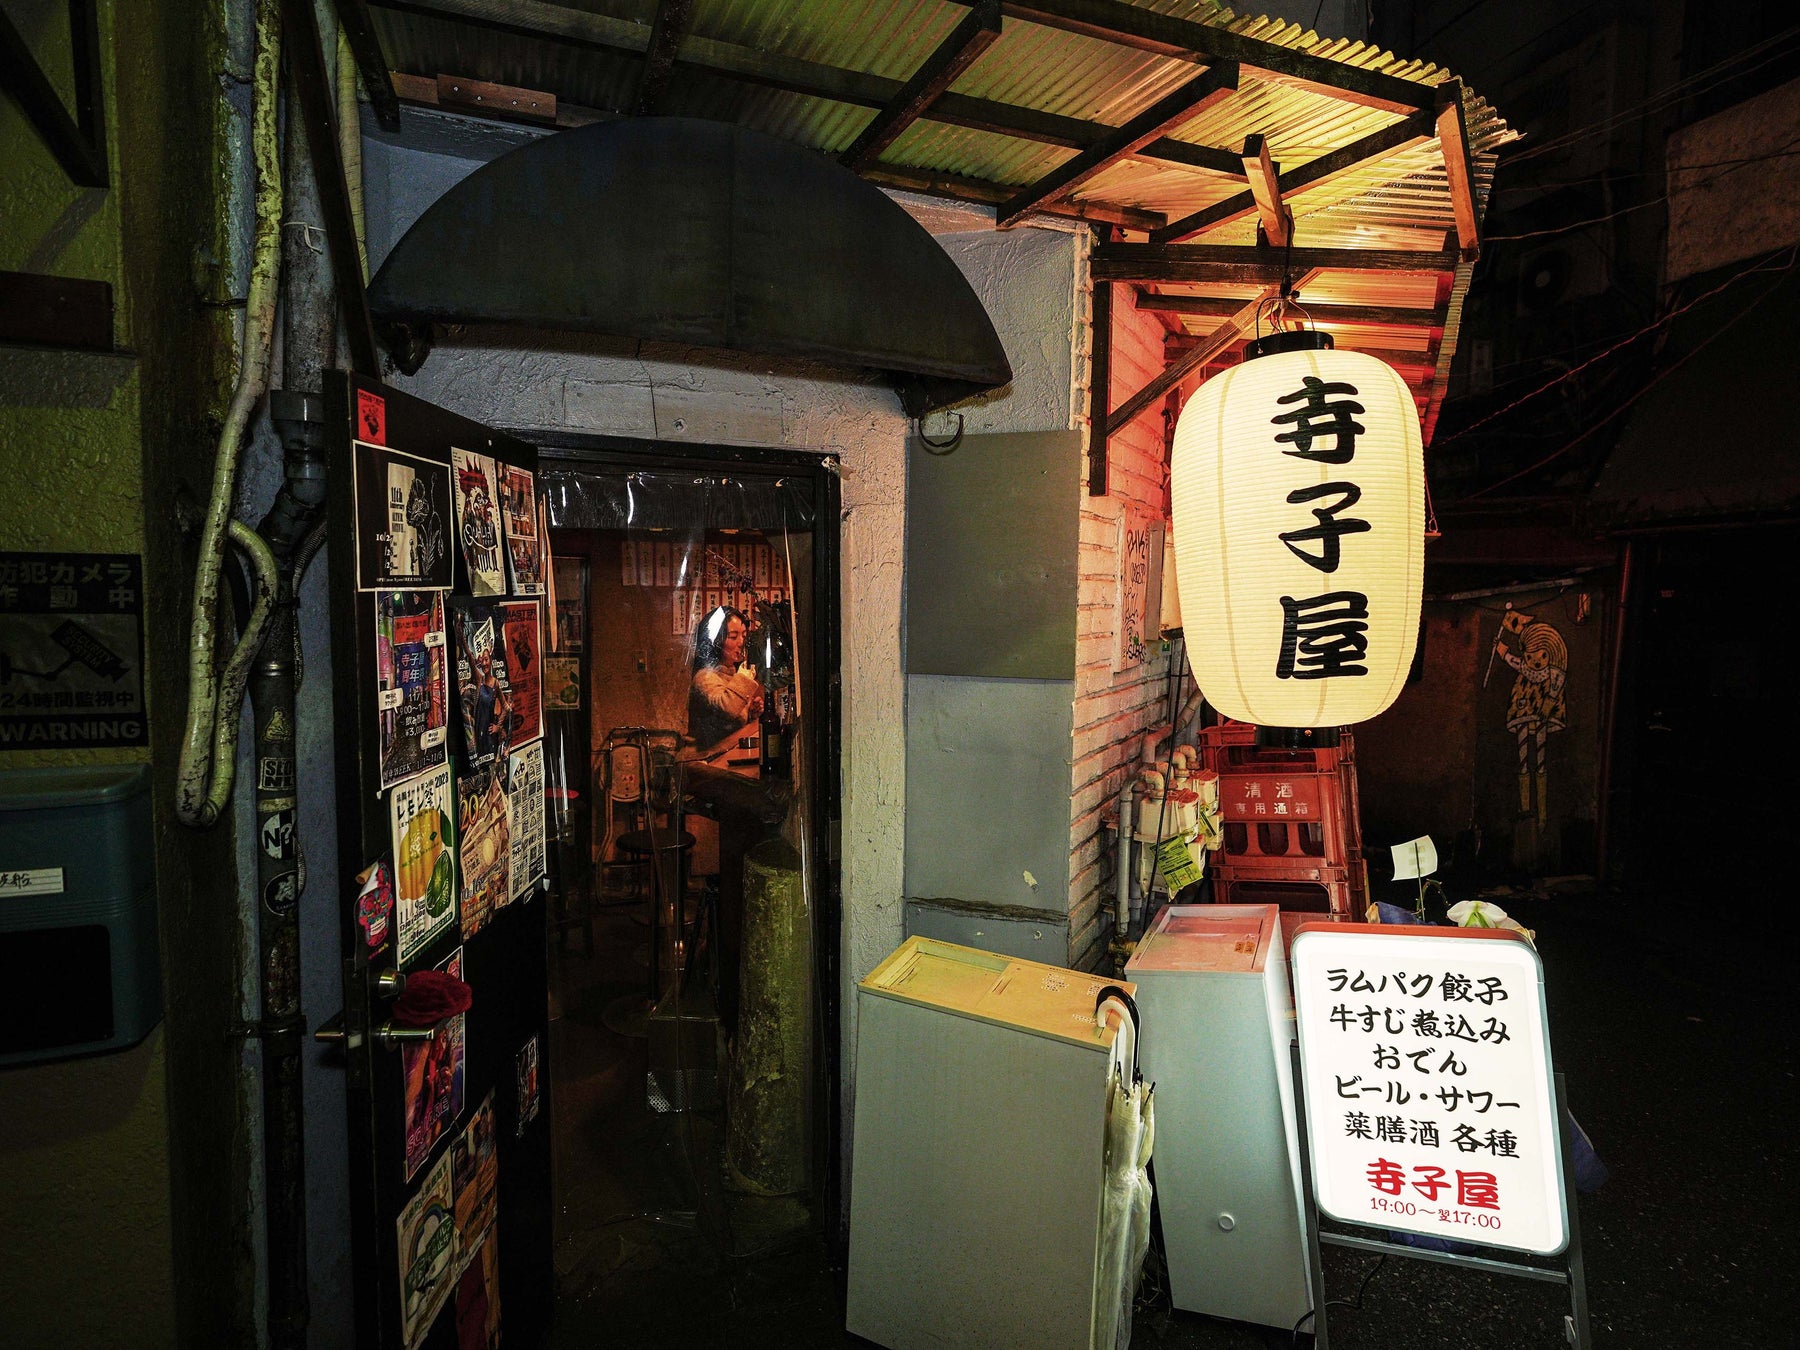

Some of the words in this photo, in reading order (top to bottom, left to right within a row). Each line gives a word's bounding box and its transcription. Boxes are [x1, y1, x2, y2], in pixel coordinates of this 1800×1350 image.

[1271, 376, 1372, 680] 寺子屋
[0, 720, 141, 742] WARNING
[1234, 802, 1309, 815] 専用通箱
[1244, 782, 1294, 799] 清酒
[1327, 968, 1509, 1006] ラムパク餃子
[1329, 1004, 1511, 1044] 牛すじ煮込み
[1373, 1043, 1467, 1076] おでん
[1335, 1075, 1521, 1113] ビール・サワー
[1366, 1157, 1501, 1210] 寺子屋
